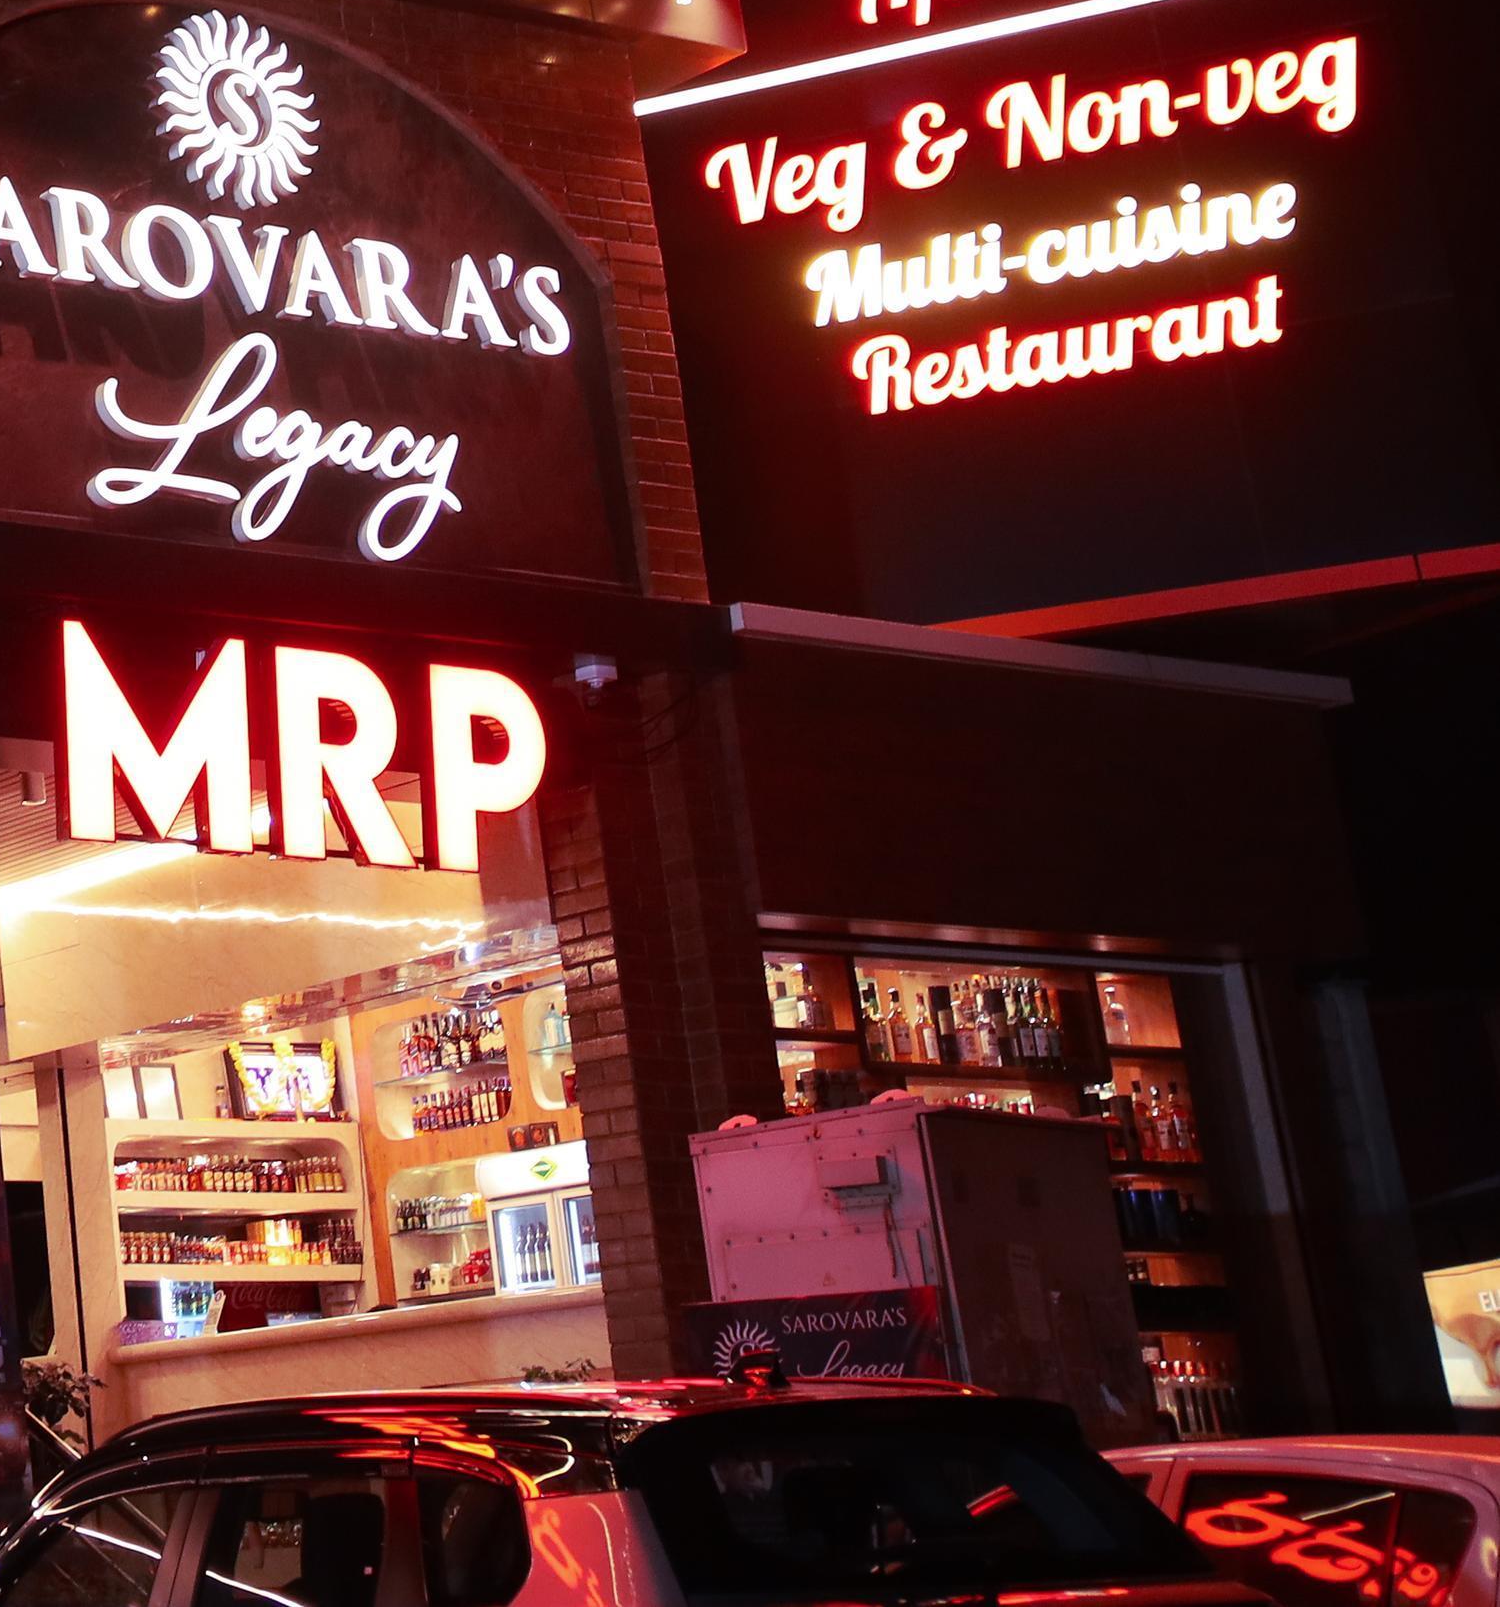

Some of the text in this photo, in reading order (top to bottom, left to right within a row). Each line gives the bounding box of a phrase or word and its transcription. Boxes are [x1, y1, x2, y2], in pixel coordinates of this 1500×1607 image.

[704, 35, 1359, 234] Veg & Non-veg
[803, 180, 1299, 329] Multi-cuisine
[850, 274, 1285, 416] Restaurant
[86, 331, 464, 563] Legacy
[62, 619, 547, 873] MRP
[781, 1307, 907, 1335] SAROVARA'S
